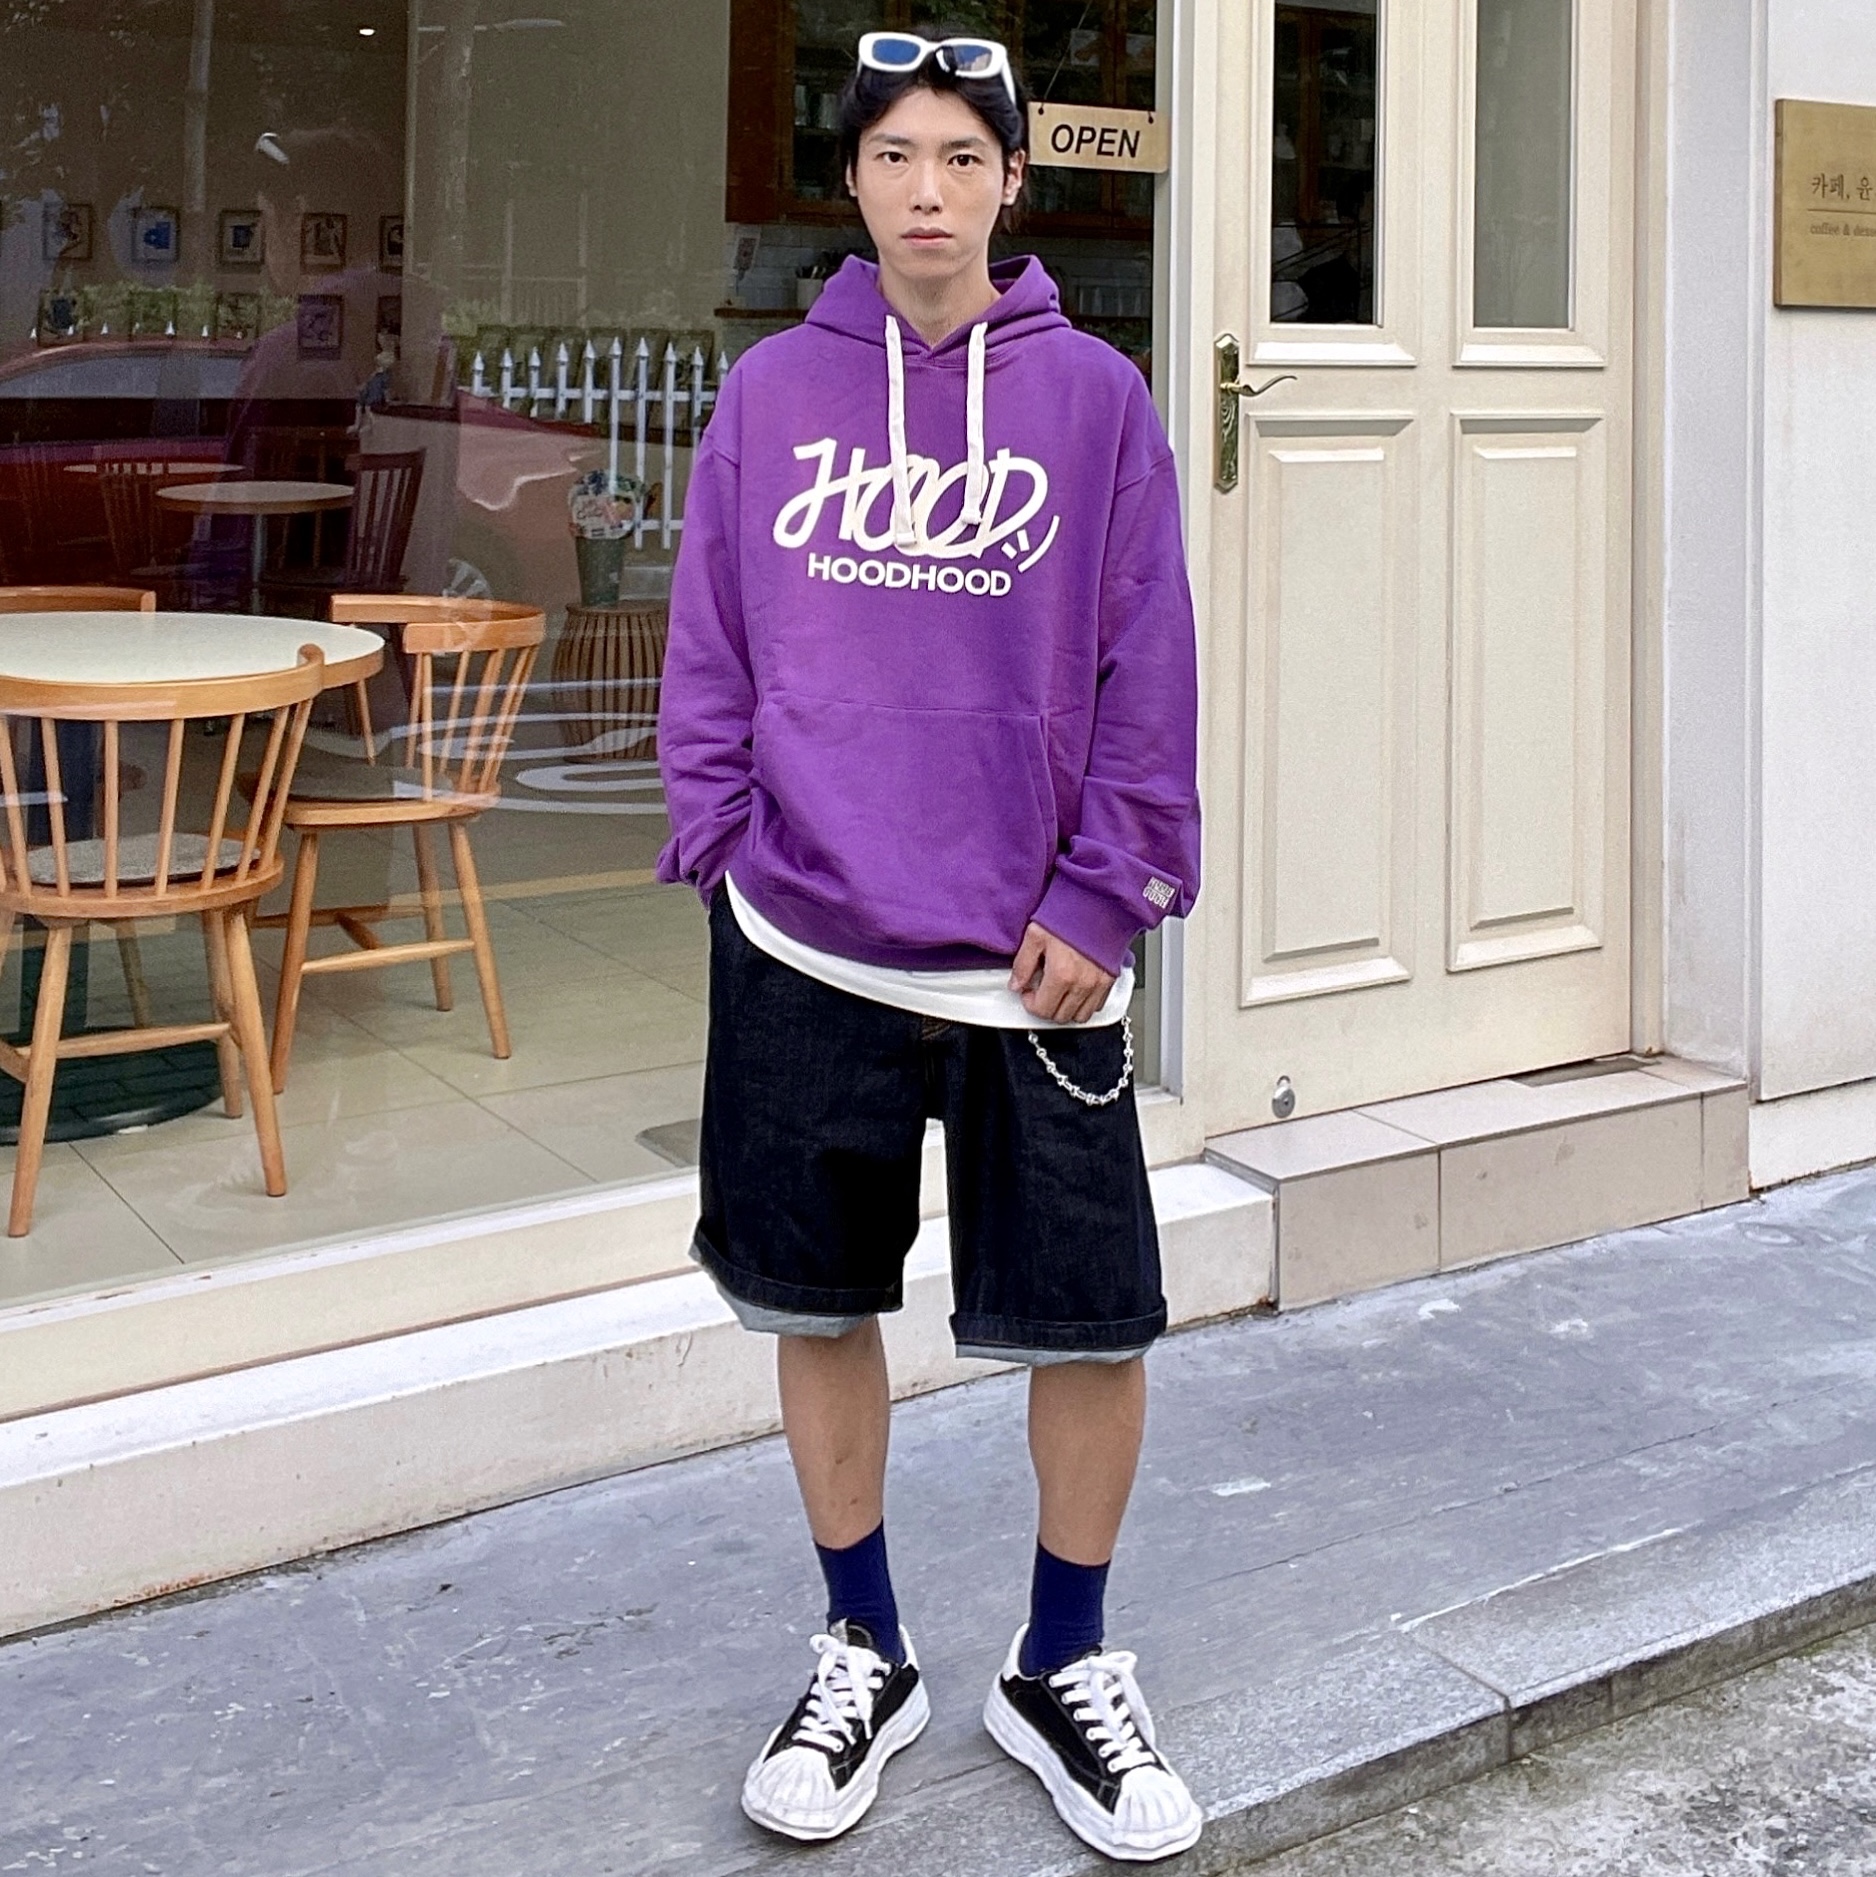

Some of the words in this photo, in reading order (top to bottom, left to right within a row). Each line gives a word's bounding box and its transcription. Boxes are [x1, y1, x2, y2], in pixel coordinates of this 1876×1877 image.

[1051, 124, 1140, 158] OPEN
[1811, 173, 1850, 200] 카페,
[1810, 222, 1839, 235] coffee
[1843, 223, 1851, 236] &
[807, 552, 1011, 597] HOODHOOD
